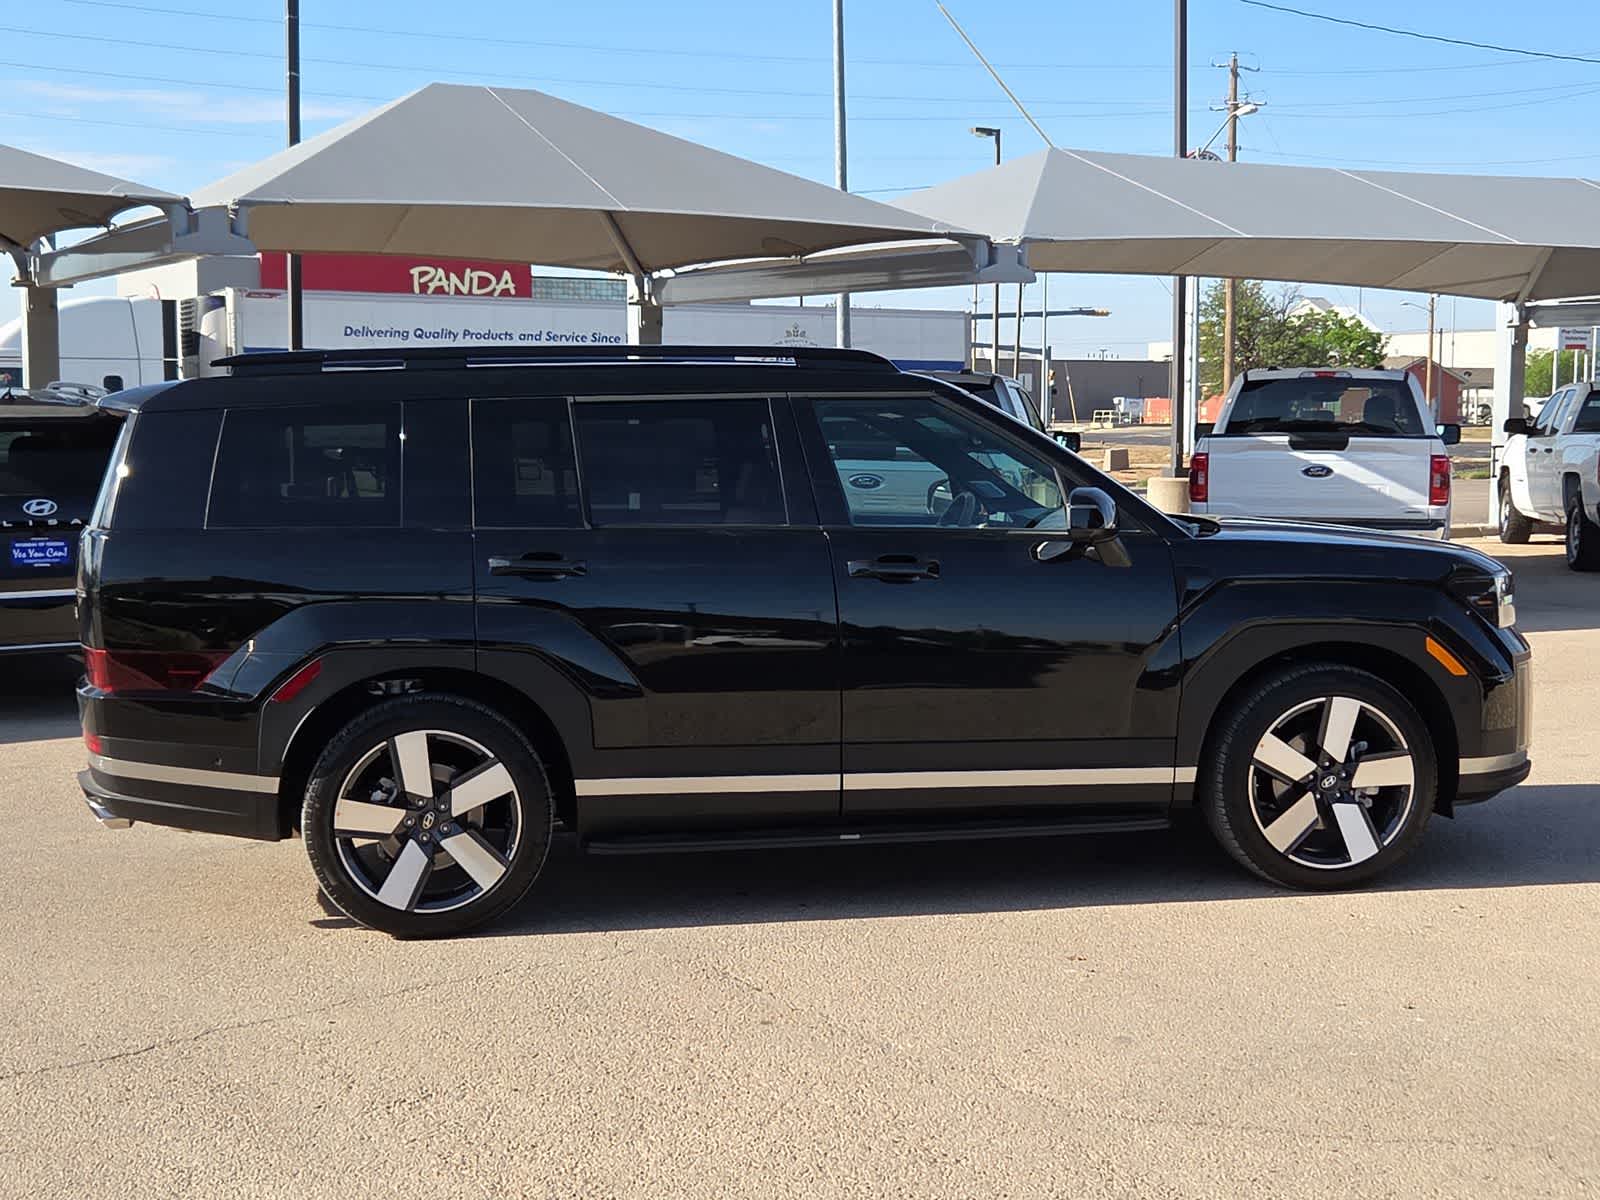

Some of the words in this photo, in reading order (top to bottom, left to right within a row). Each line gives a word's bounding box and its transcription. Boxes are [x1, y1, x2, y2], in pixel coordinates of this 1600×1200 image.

[409, 265, 516, 297] PANDA
[343, 325, 409, 341] Delivering
[413, 327, 458, 342] Quality
[462, 328, 514, 341] Products
[518, 330, 542, 341] and
[545, 331, 587, 343] Service
[590, 332, 621, 344] Since
[12, 549, 27, 559] Yes
[28, 548, 45, 558] You
[46, 546, 68, 558] Can!
